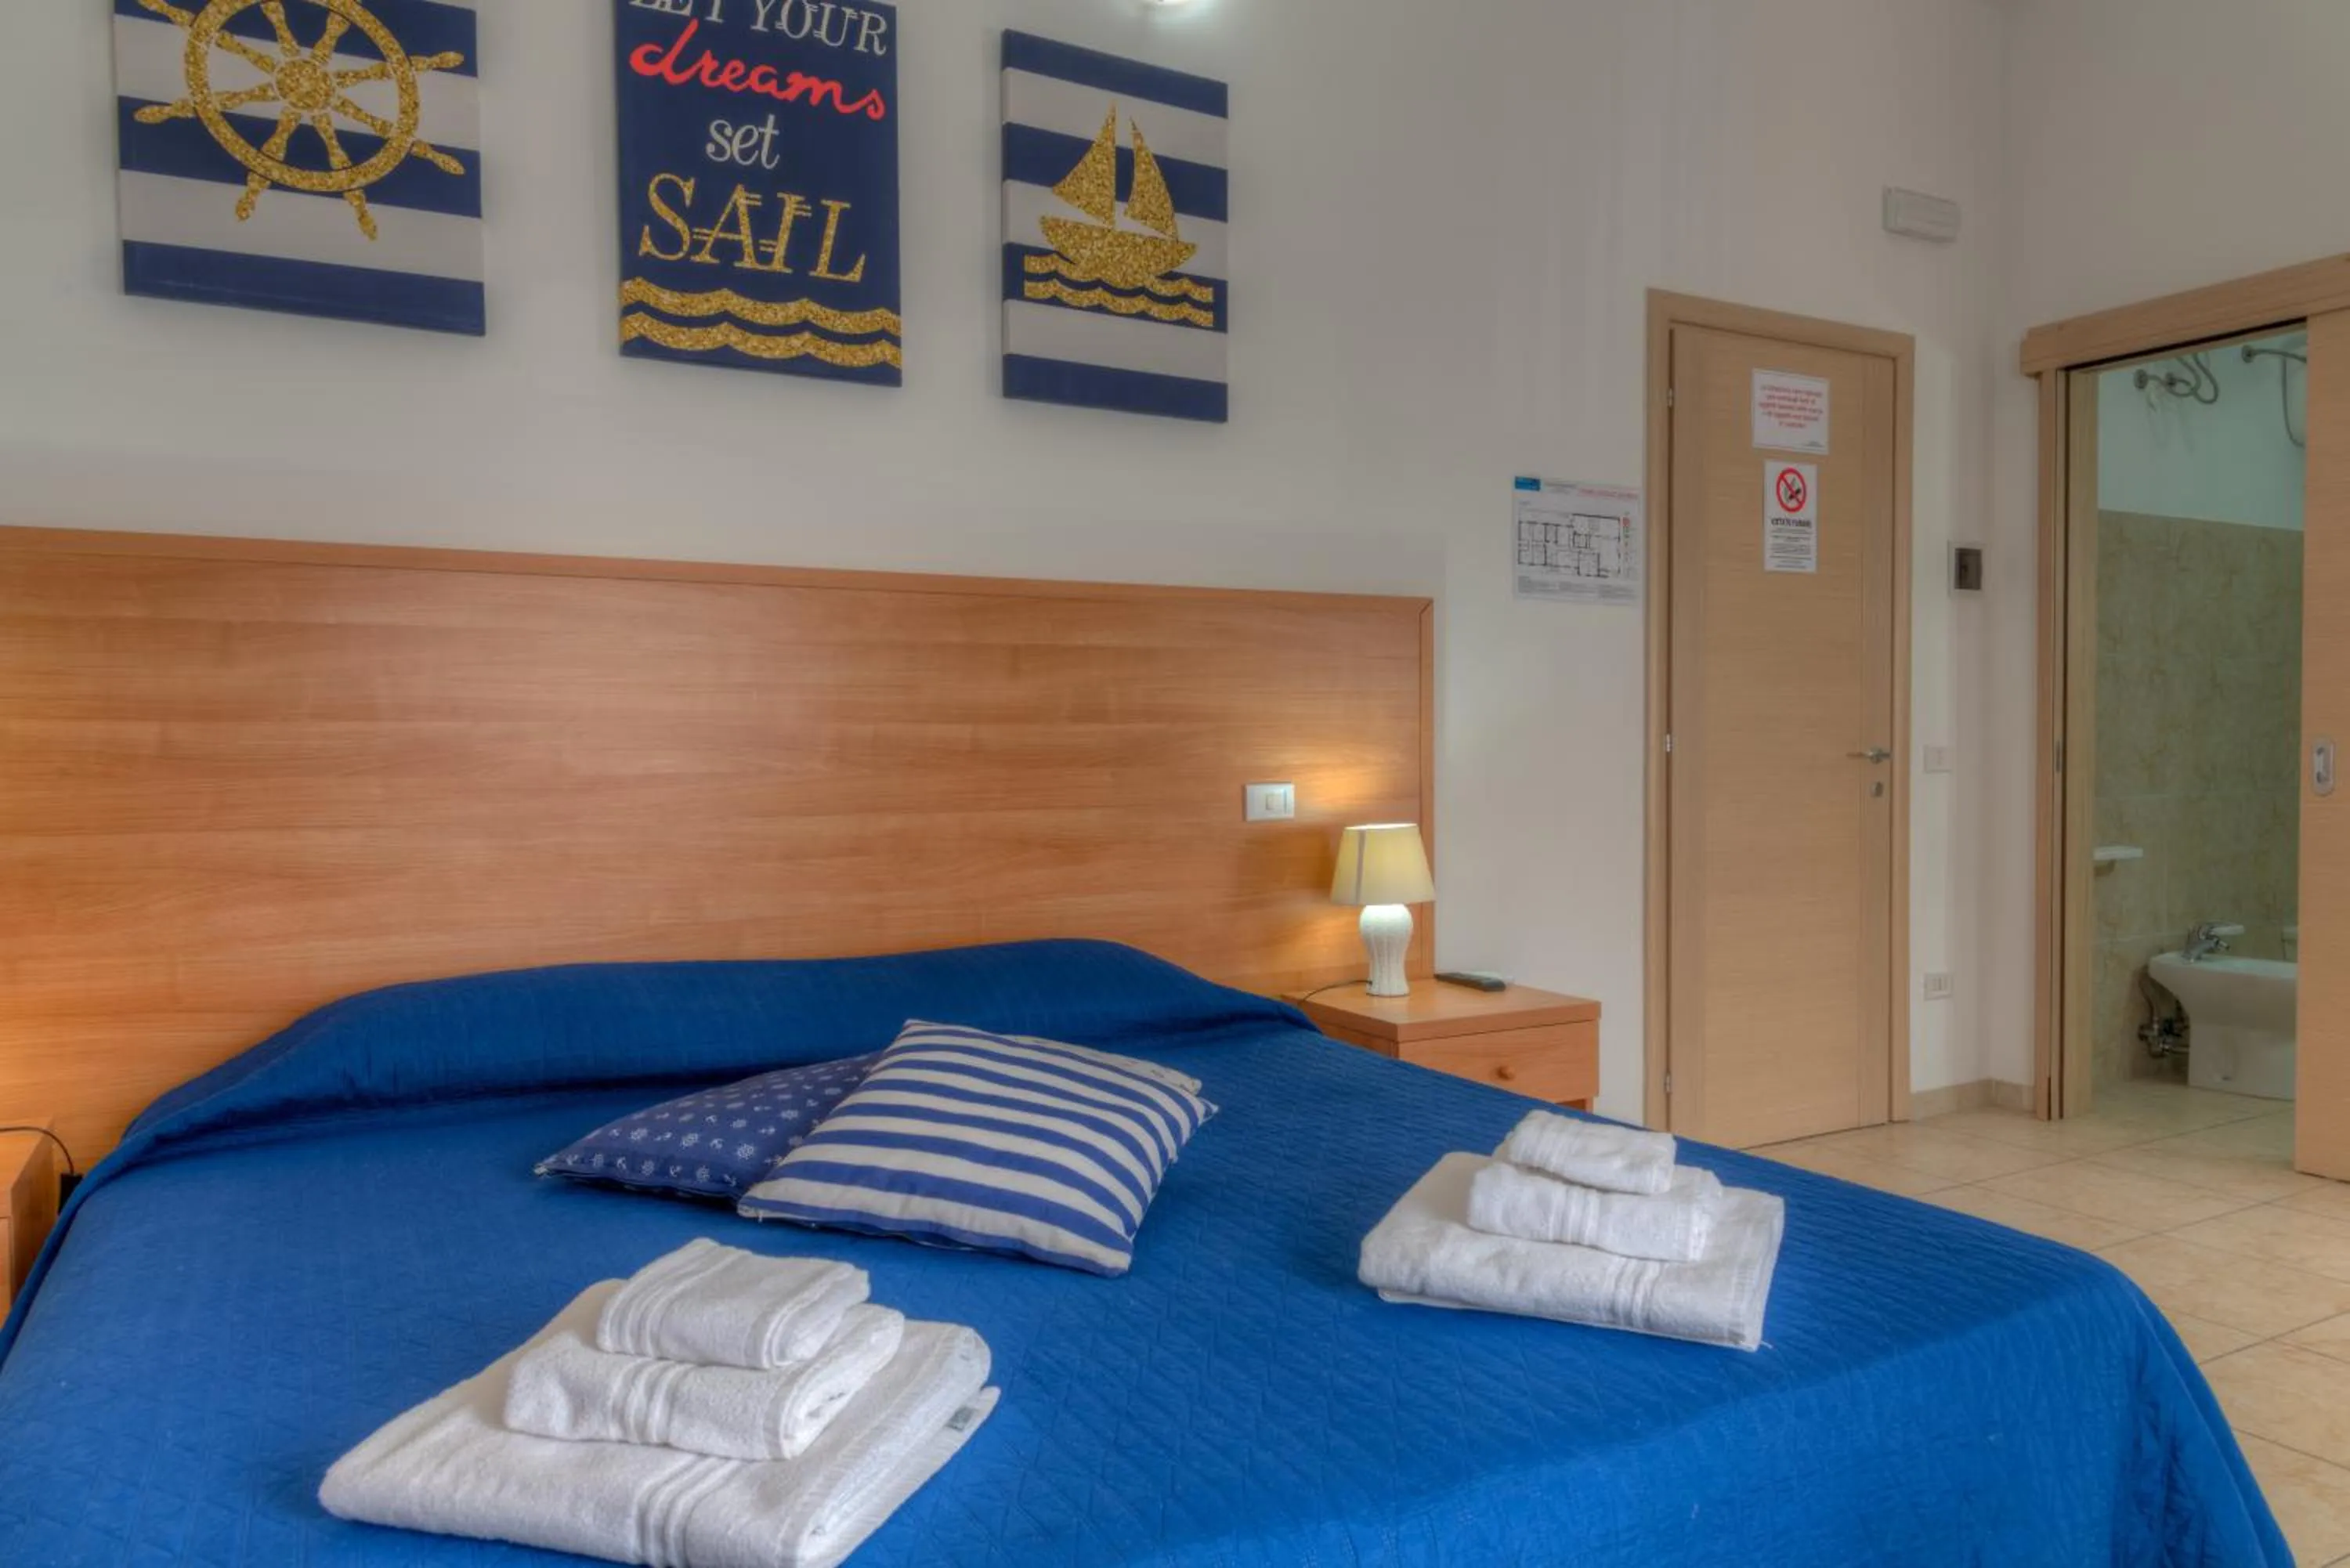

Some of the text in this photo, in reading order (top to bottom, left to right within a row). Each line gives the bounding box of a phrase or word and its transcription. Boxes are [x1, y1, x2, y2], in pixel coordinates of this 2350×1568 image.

[750, 0, 887, 56] YOUR
[629, 18, 886, 120] dreams
[706, 114, 780, 169] set
[638, 173, 866, 283] SAIL
